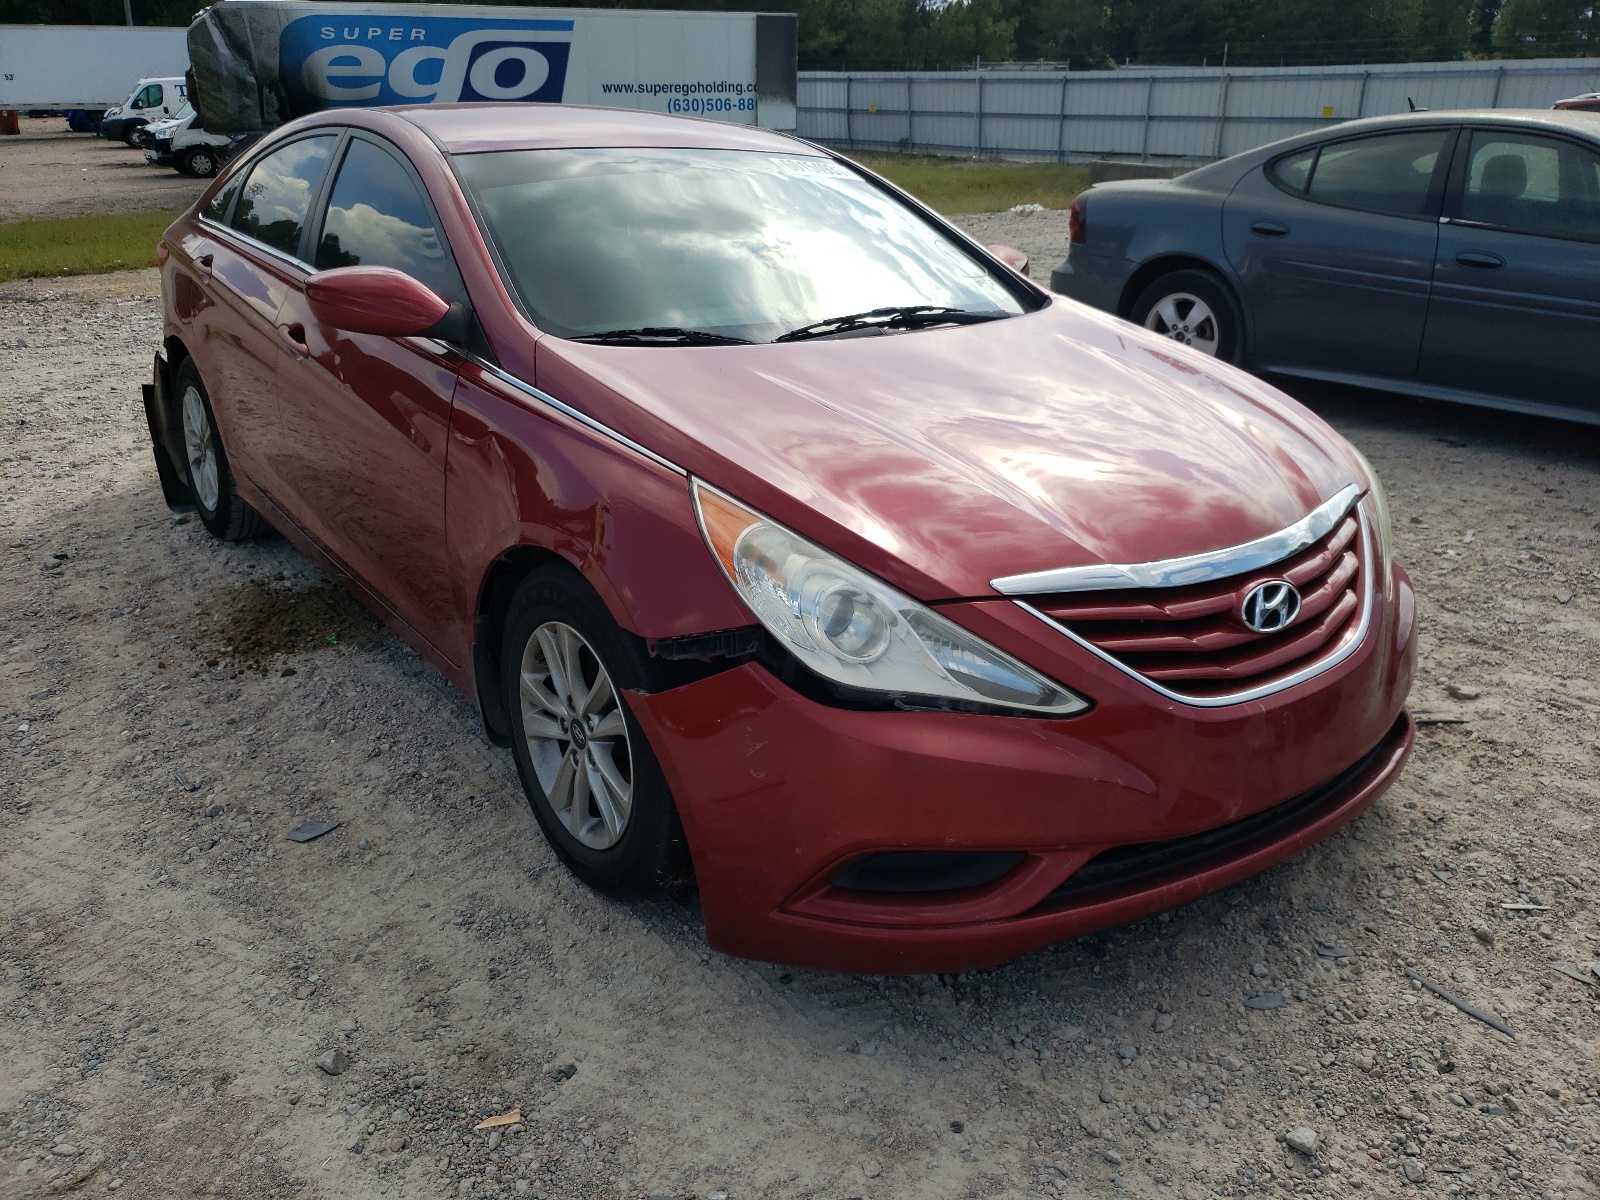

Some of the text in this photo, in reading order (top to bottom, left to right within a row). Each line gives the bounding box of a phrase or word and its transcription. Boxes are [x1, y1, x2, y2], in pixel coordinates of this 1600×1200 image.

[320, 26, 426, 41] SUPER
[301, 44, 550, 103] ego
[667, 98, 757, 115] (630)506-88
